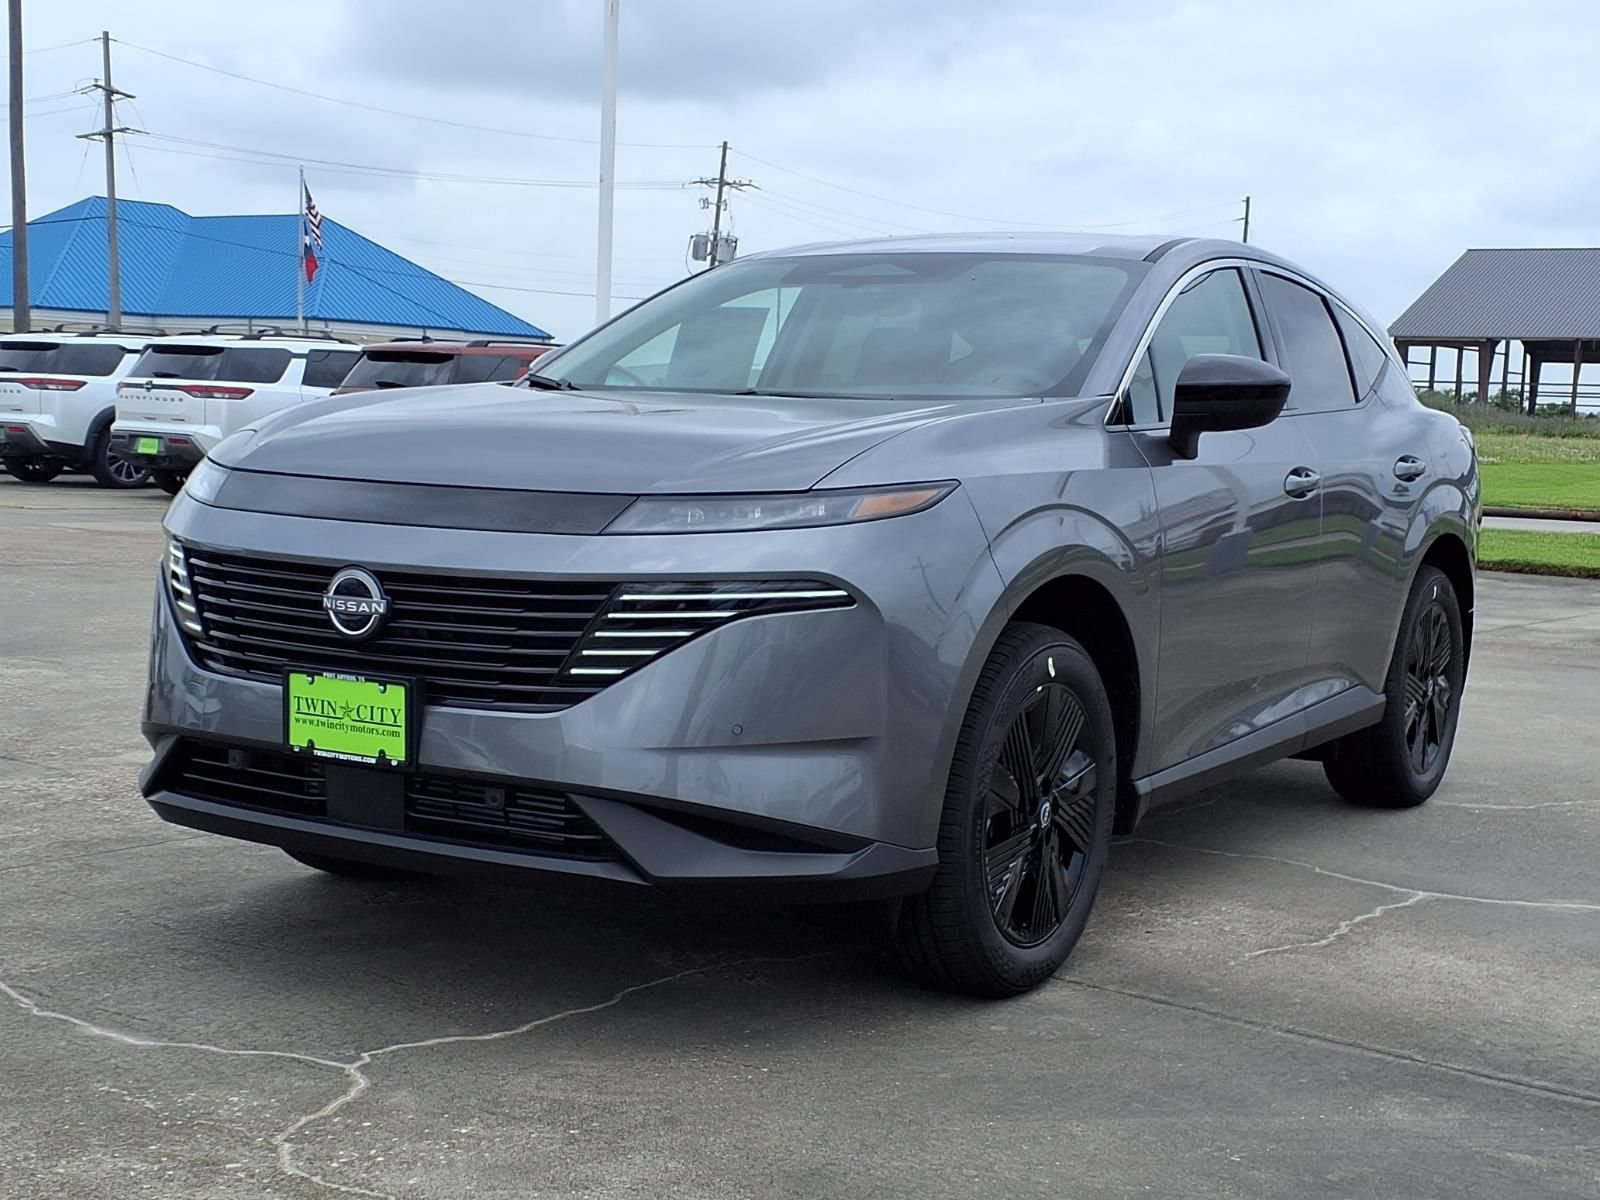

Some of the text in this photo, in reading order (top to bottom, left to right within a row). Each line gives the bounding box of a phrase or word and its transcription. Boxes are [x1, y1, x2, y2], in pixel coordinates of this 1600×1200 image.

[323, 597, 384, 614] NISSAN
[293, 695, 401, 723] TWIN CITY
[294, 717, 401, 738] www.twincitymotors.com
